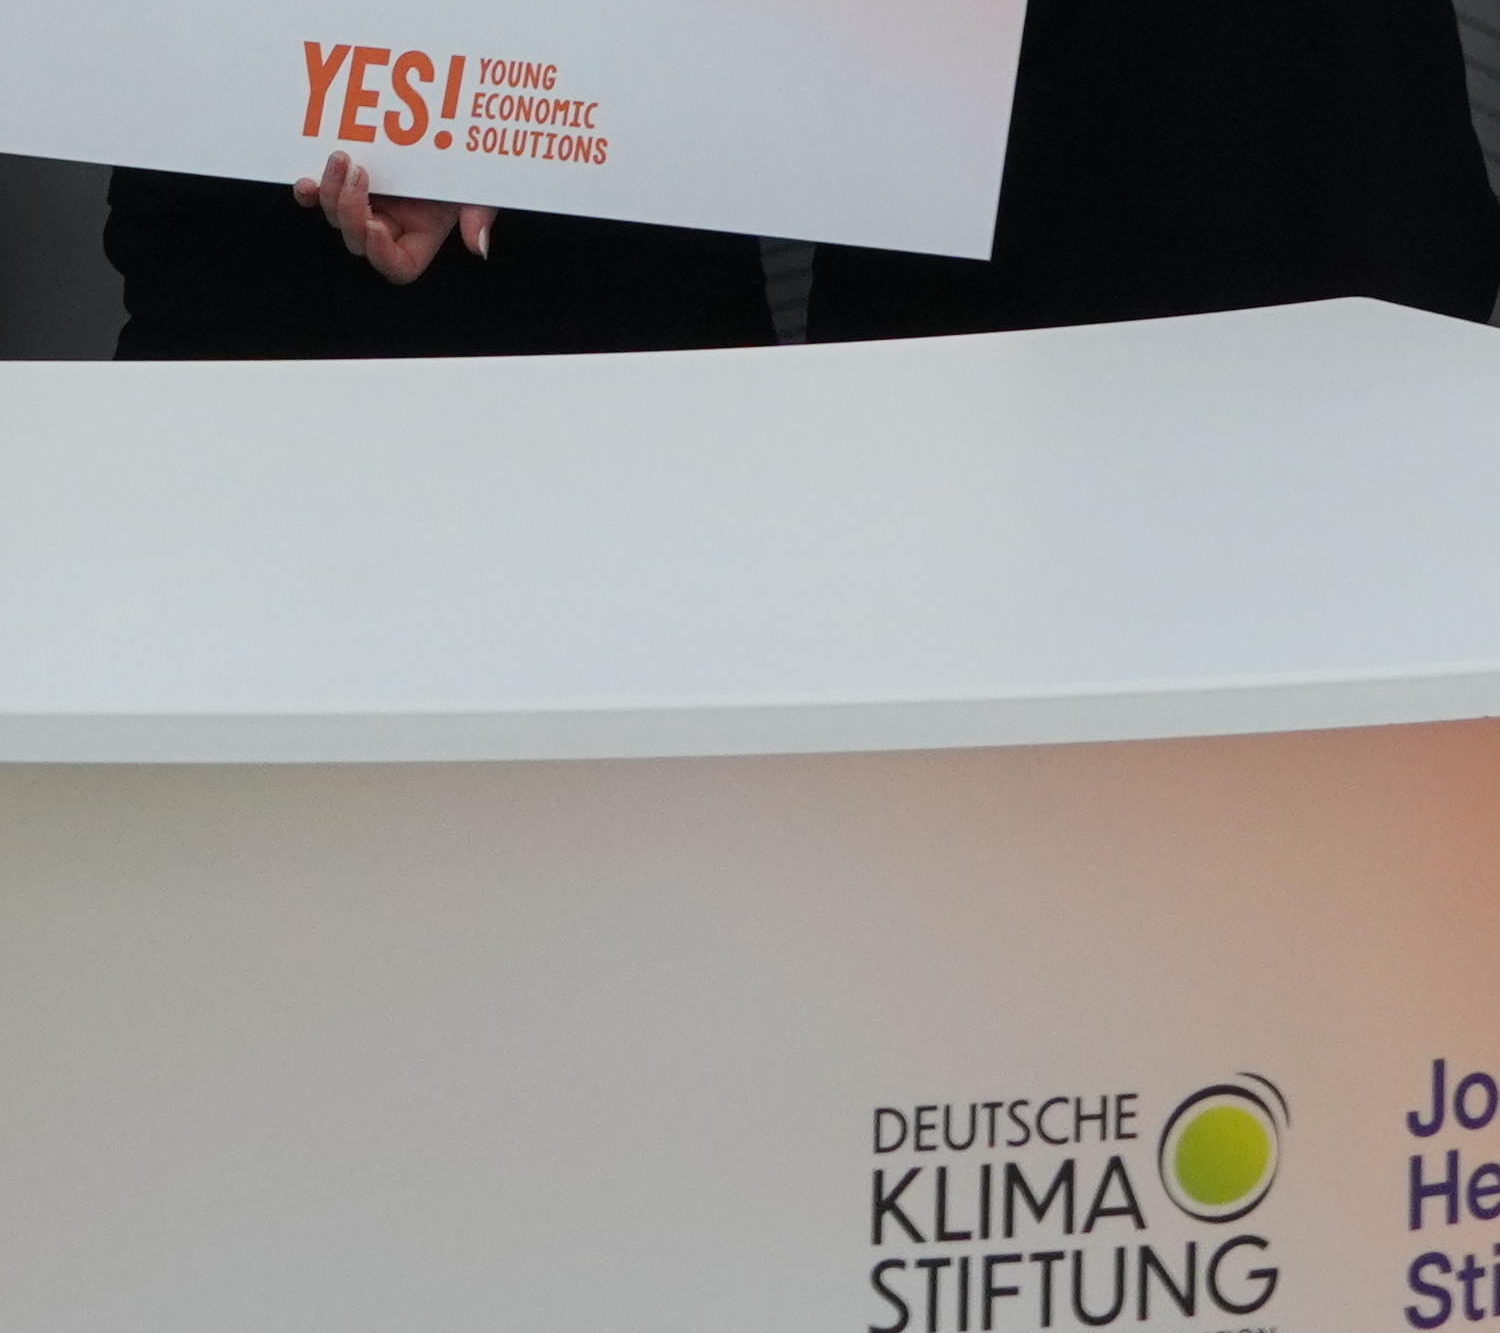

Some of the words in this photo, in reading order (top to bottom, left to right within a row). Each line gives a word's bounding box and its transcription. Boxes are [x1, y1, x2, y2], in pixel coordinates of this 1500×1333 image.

[302, 40, 466, 151] YES!
[479, 57, 558, 91] YOUNG
[470, 93, 598, 131] ECONOMIC
[465, 125, 608, 166] SOLUTIONS
[873, 1092, 1138, 1154] DEUTSCHE
[871, 1155, 1147, 1246] KLIMA
[868, 1234, 1279, 1333] STIFTUNG
